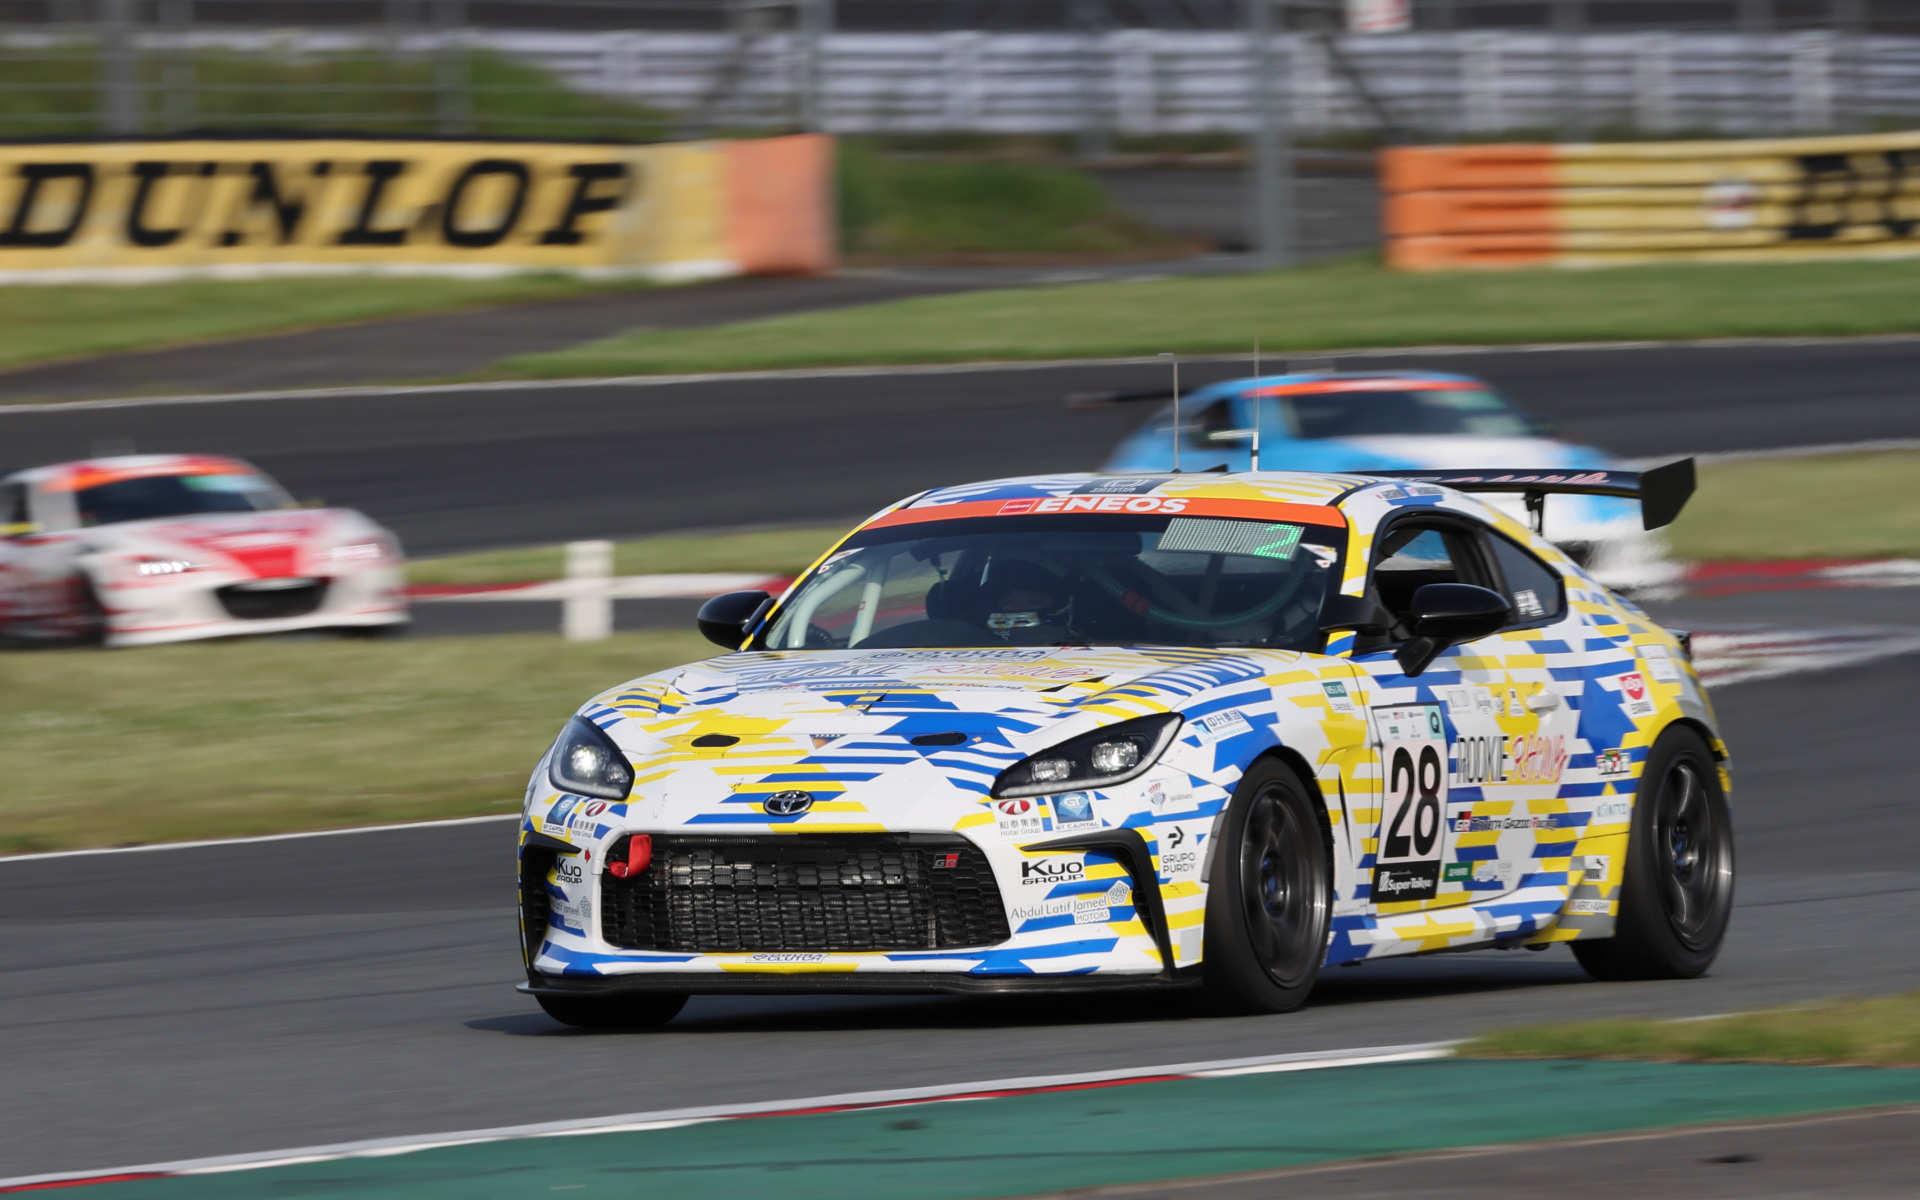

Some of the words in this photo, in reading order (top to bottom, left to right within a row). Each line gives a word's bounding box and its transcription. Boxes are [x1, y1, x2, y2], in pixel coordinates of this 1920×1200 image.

[1034, 497, 1190, 513] ENEOS
[1253, 523, 1300, 560] 2
[1430, 711, 1441, 734] Q
[1456, 735, 1509, 783] ROOKIE
[1383, 744, 1441, 858] 28
[999, 818, 1040, 830] 和泰集團
[1067, 821, 1099, 829] CAPITAL
[1000, 829, 1020, 837] Hotai
[1021, 826, 1041, 836] Group
[1162, 852, 1196, 864] GRUPO
[1163, 863, 1196, 874] PURDY
[1022, 873, 1084, 885] GROUP
[1010, 904, 1044, 920] Abdul
[1046, 901, 1072, 915] Latif
[1073, 895, 1107, 912] Jameel
[1076, 910, 1109, 922] MOTORS
